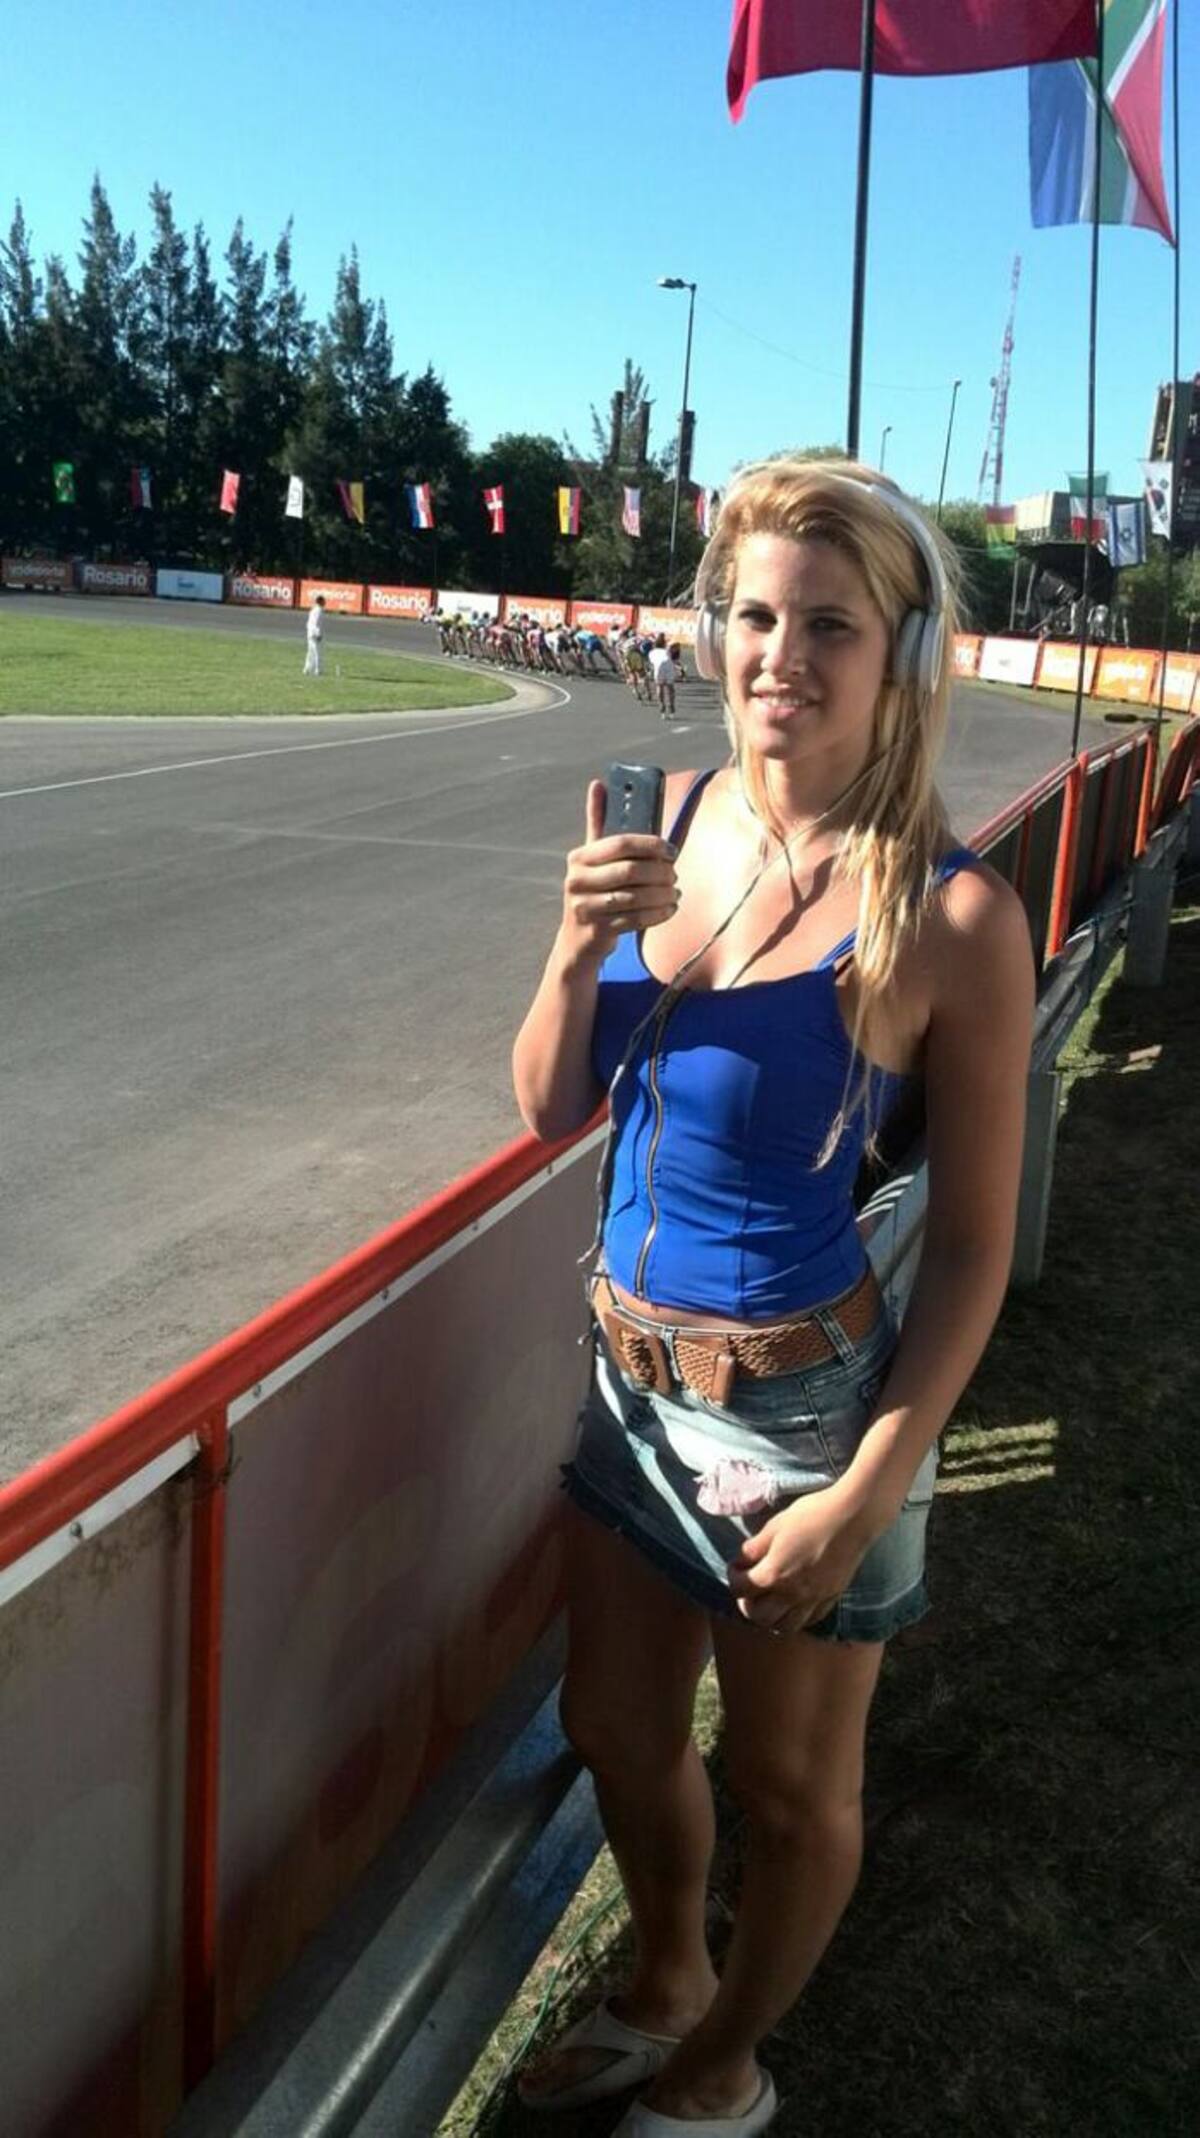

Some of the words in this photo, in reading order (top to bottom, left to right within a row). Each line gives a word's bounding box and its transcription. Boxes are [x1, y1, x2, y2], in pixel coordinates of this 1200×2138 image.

[84, 565, 147, 586] Rosario
[233, 577, 291, 600] Rosario
[372, 589, 428, 611] Rosario
